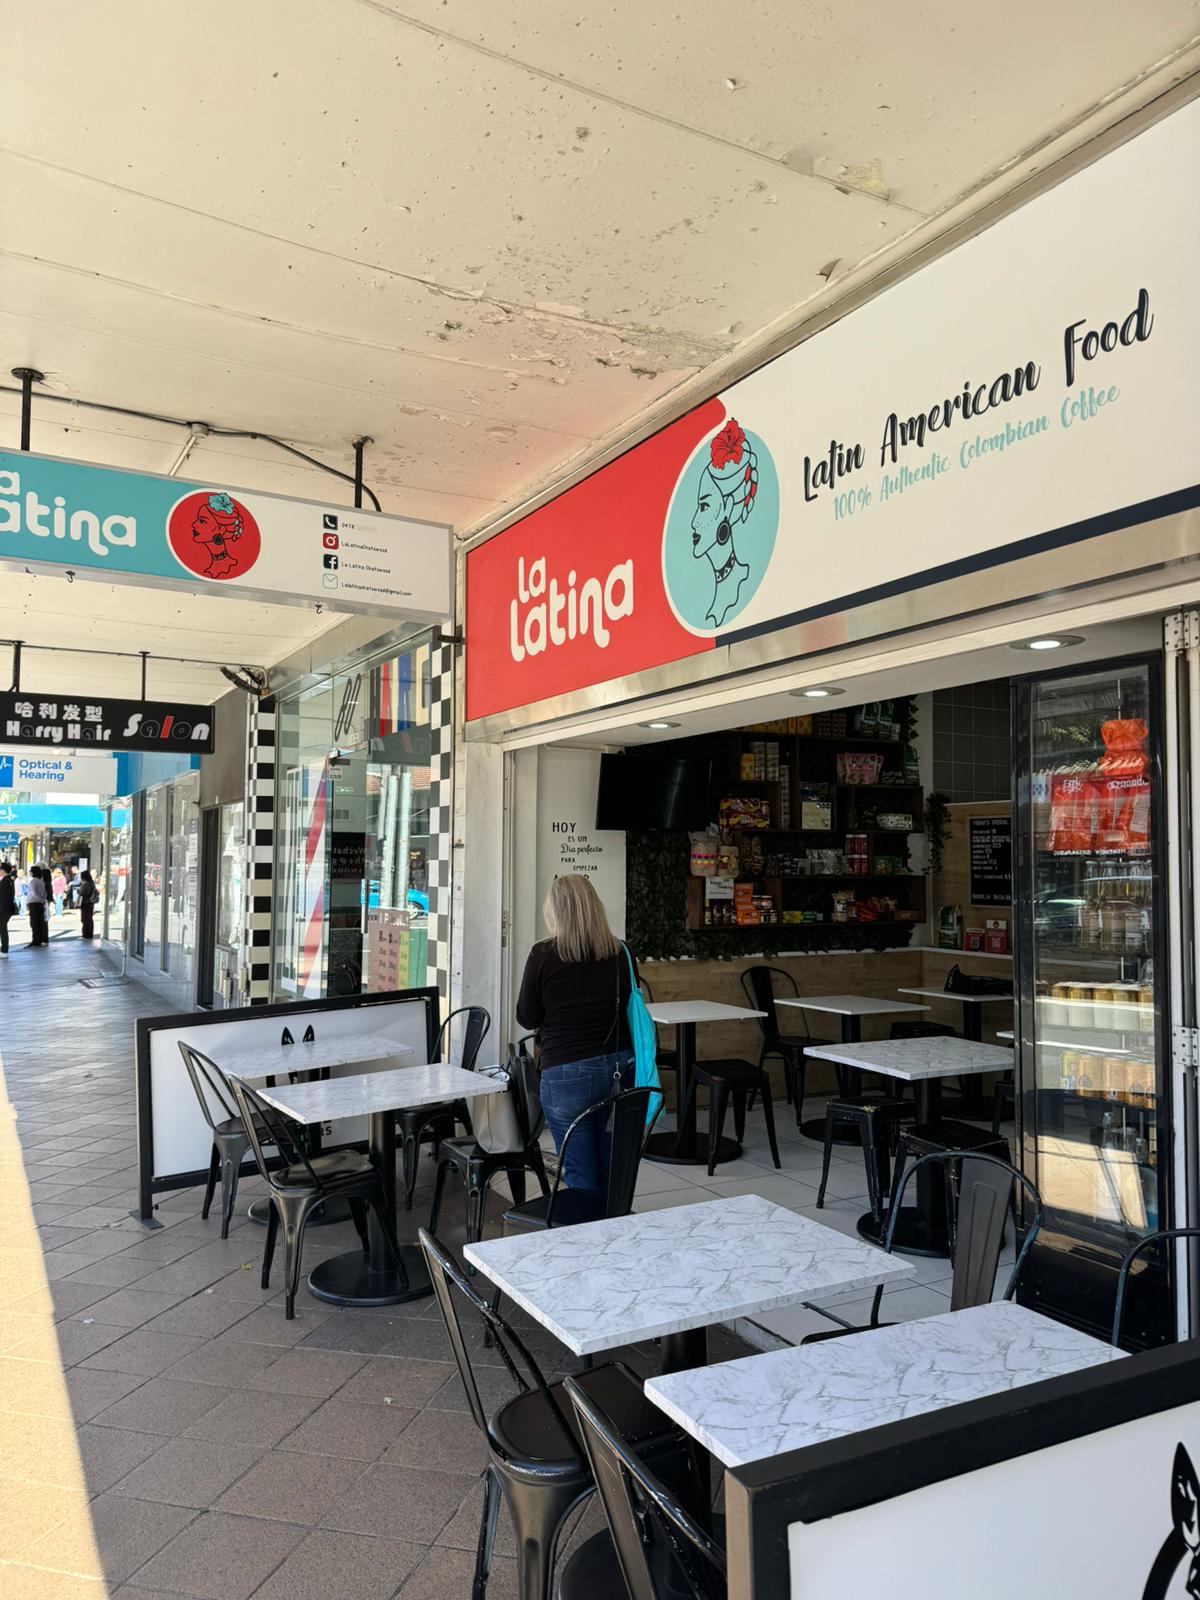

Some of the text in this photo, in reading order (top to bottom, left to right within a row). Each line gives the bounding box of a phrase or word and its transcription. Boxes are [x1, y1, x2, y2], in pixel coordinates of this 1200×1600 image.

[803, 288, 1154, 502] Latin American Food
[833, 385, 1120, 520] 100% Authentic Colombian Coffee
[0, 470, 20, 496] a
[0, 491, 137, 556] atina
[14, 701, 104, 723] 哈利发型
[6, 713, 211, 744] Harry Hair Salon
[19, 759, 73, 772] Optical &
[19, 770, 65, 782] Hearing
[552, 822, 577, 833] HOY
[577, 844, 603, 855] perfecto
